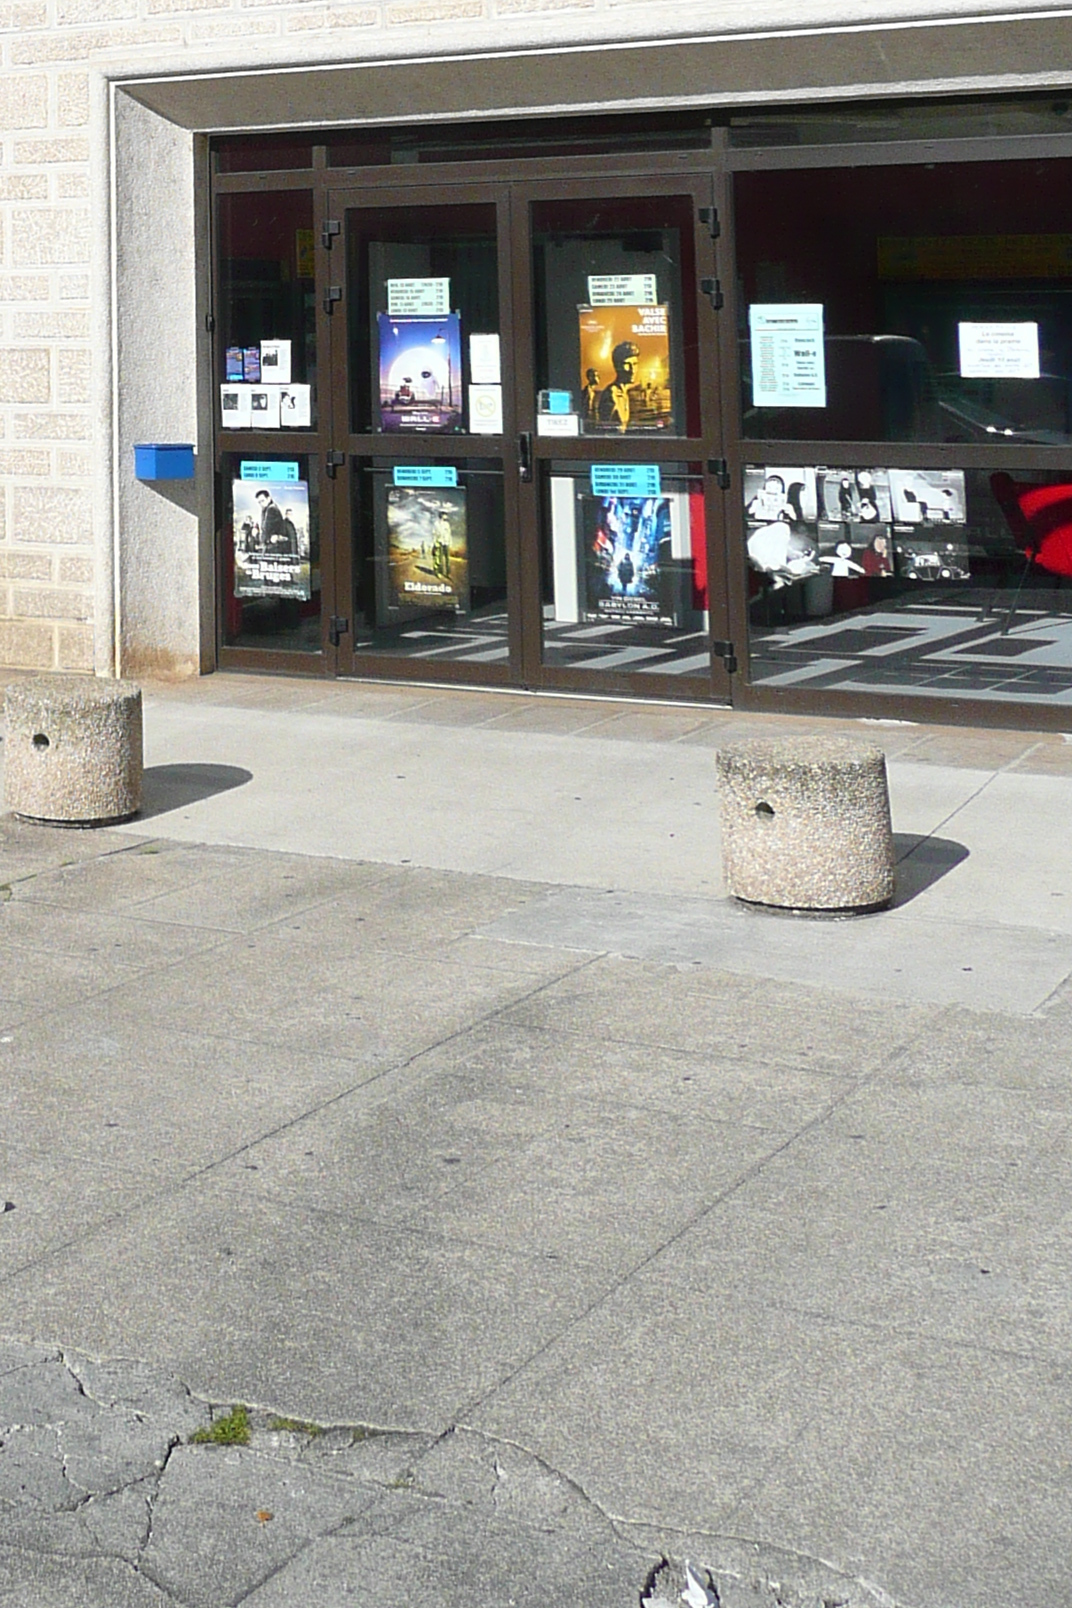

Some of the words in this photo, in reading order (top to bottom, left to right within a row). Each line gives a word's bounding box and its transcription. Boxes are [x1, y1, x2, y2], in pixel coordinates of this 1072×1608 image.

[637, 307, 666, 316] VALSE
[642, 316, 667, 325] AVEC
[404, 581, 452, 593] Eldorado
